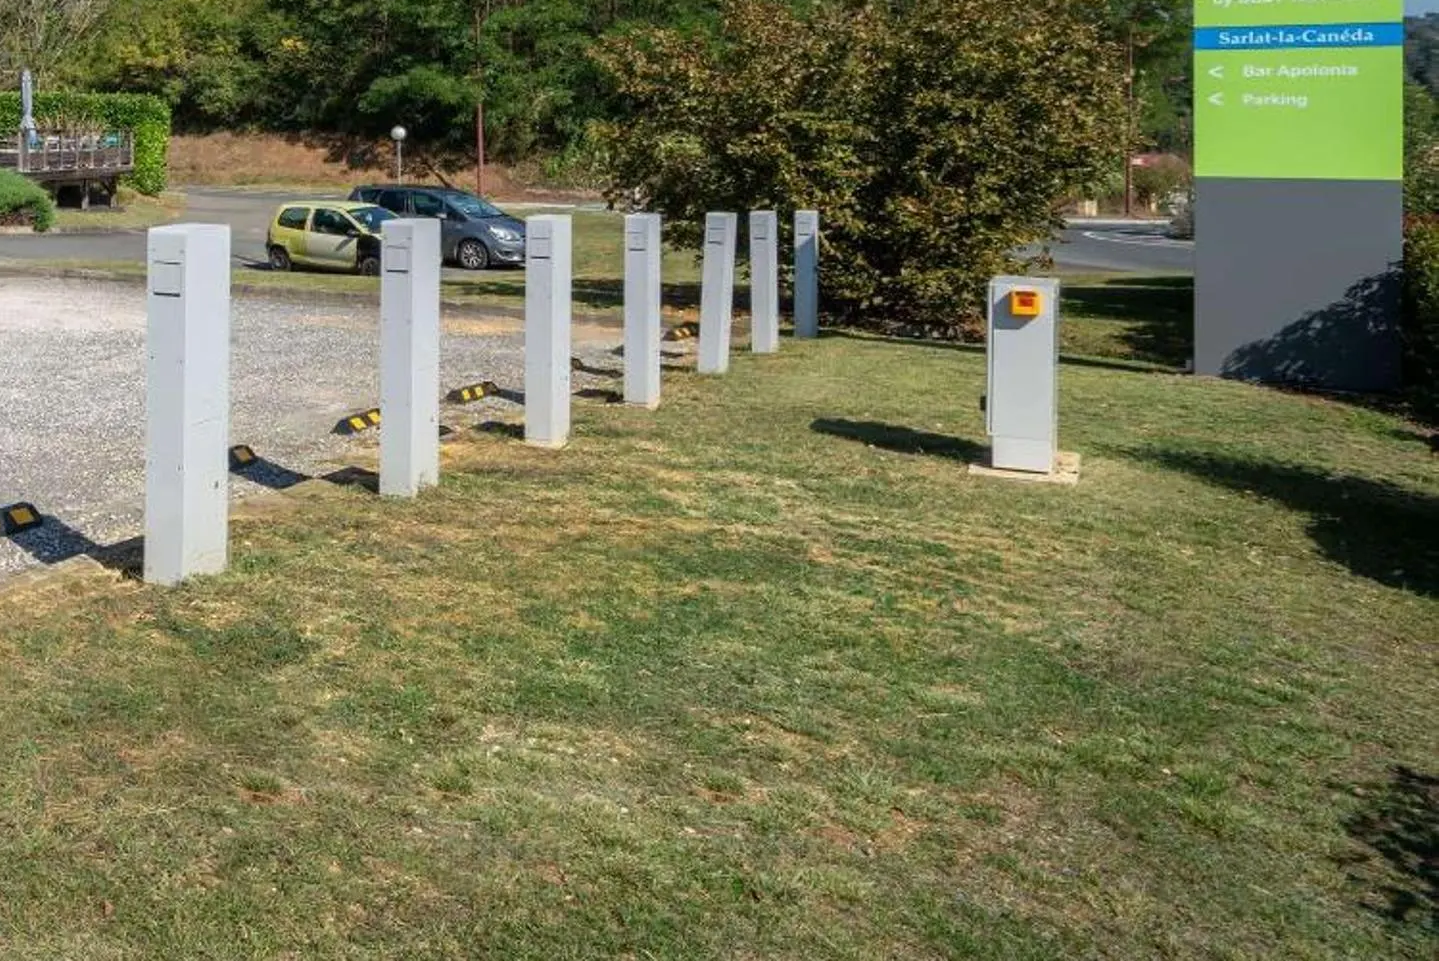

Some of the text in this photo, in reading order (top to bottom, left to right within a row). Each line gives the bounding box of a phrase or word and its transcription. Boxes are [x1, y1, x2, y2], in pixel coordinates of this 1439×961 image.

[1218, 28, 1374, 45] Sarlat-la-Canéda
[1242, 64, 1271, 77] Bar
[1242, 93, 1308, 109] Parking
